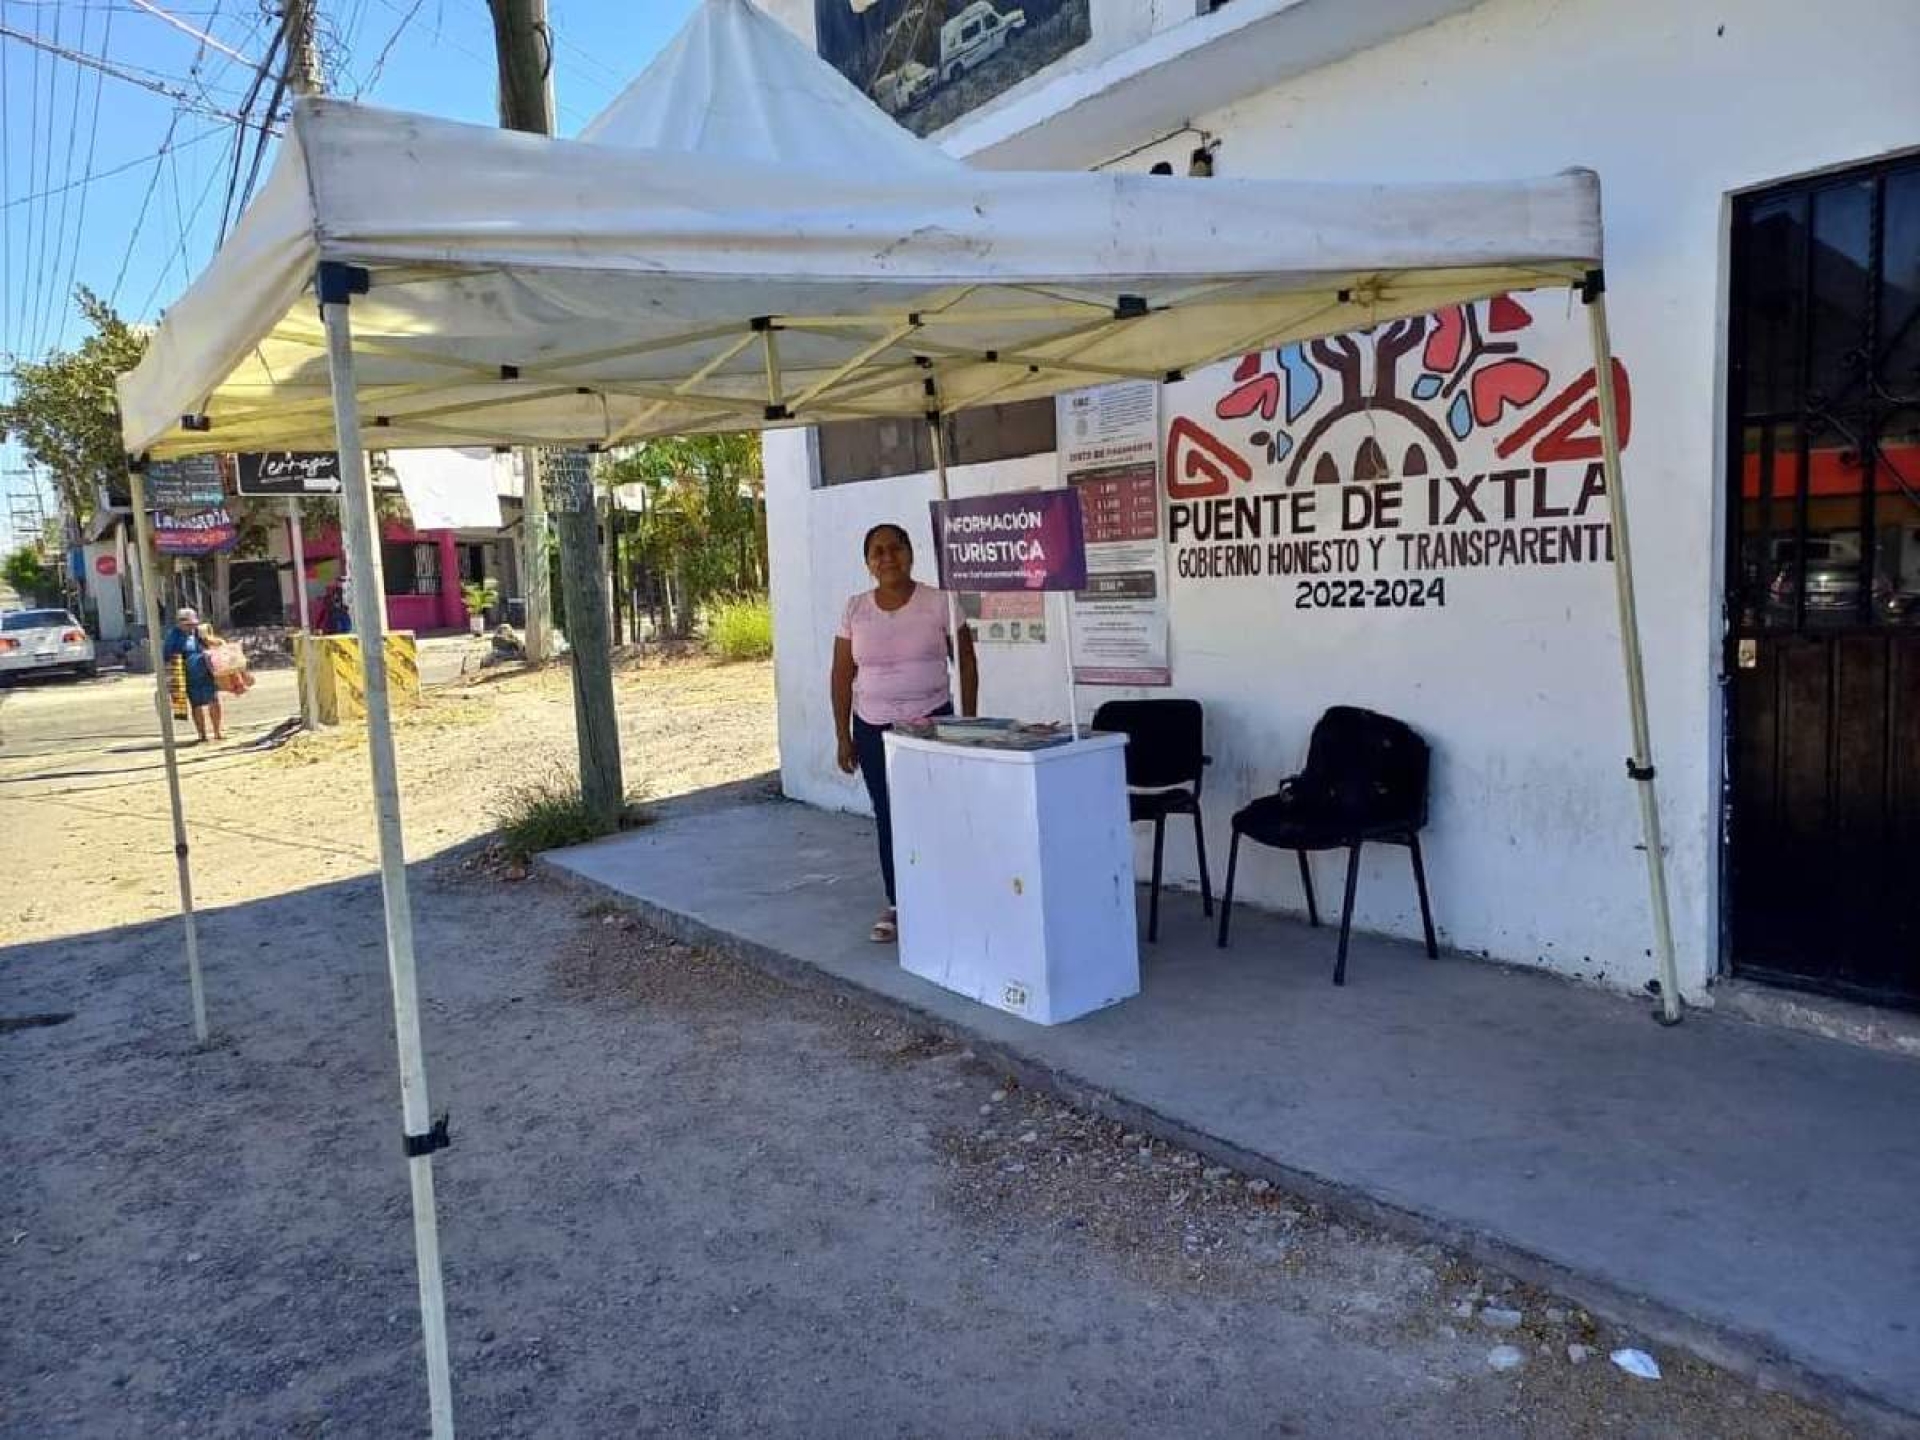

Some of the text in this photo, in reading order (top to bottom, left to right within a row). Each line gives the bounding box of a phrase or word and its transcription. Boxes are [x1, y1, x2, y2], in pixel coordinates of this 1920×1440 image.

[1170, 462, 1609, 543] PUENTE DE IXTLA
[949, 538, 1046, 563] TURÍSTICA
[1177, 547, 1262, 578] GOBIERNO
[1268, 540, 1360, 575] HONESTO
[1370, 537, 1387, 568] Y
[1295, 577, 1446, 609] 2022-2024
